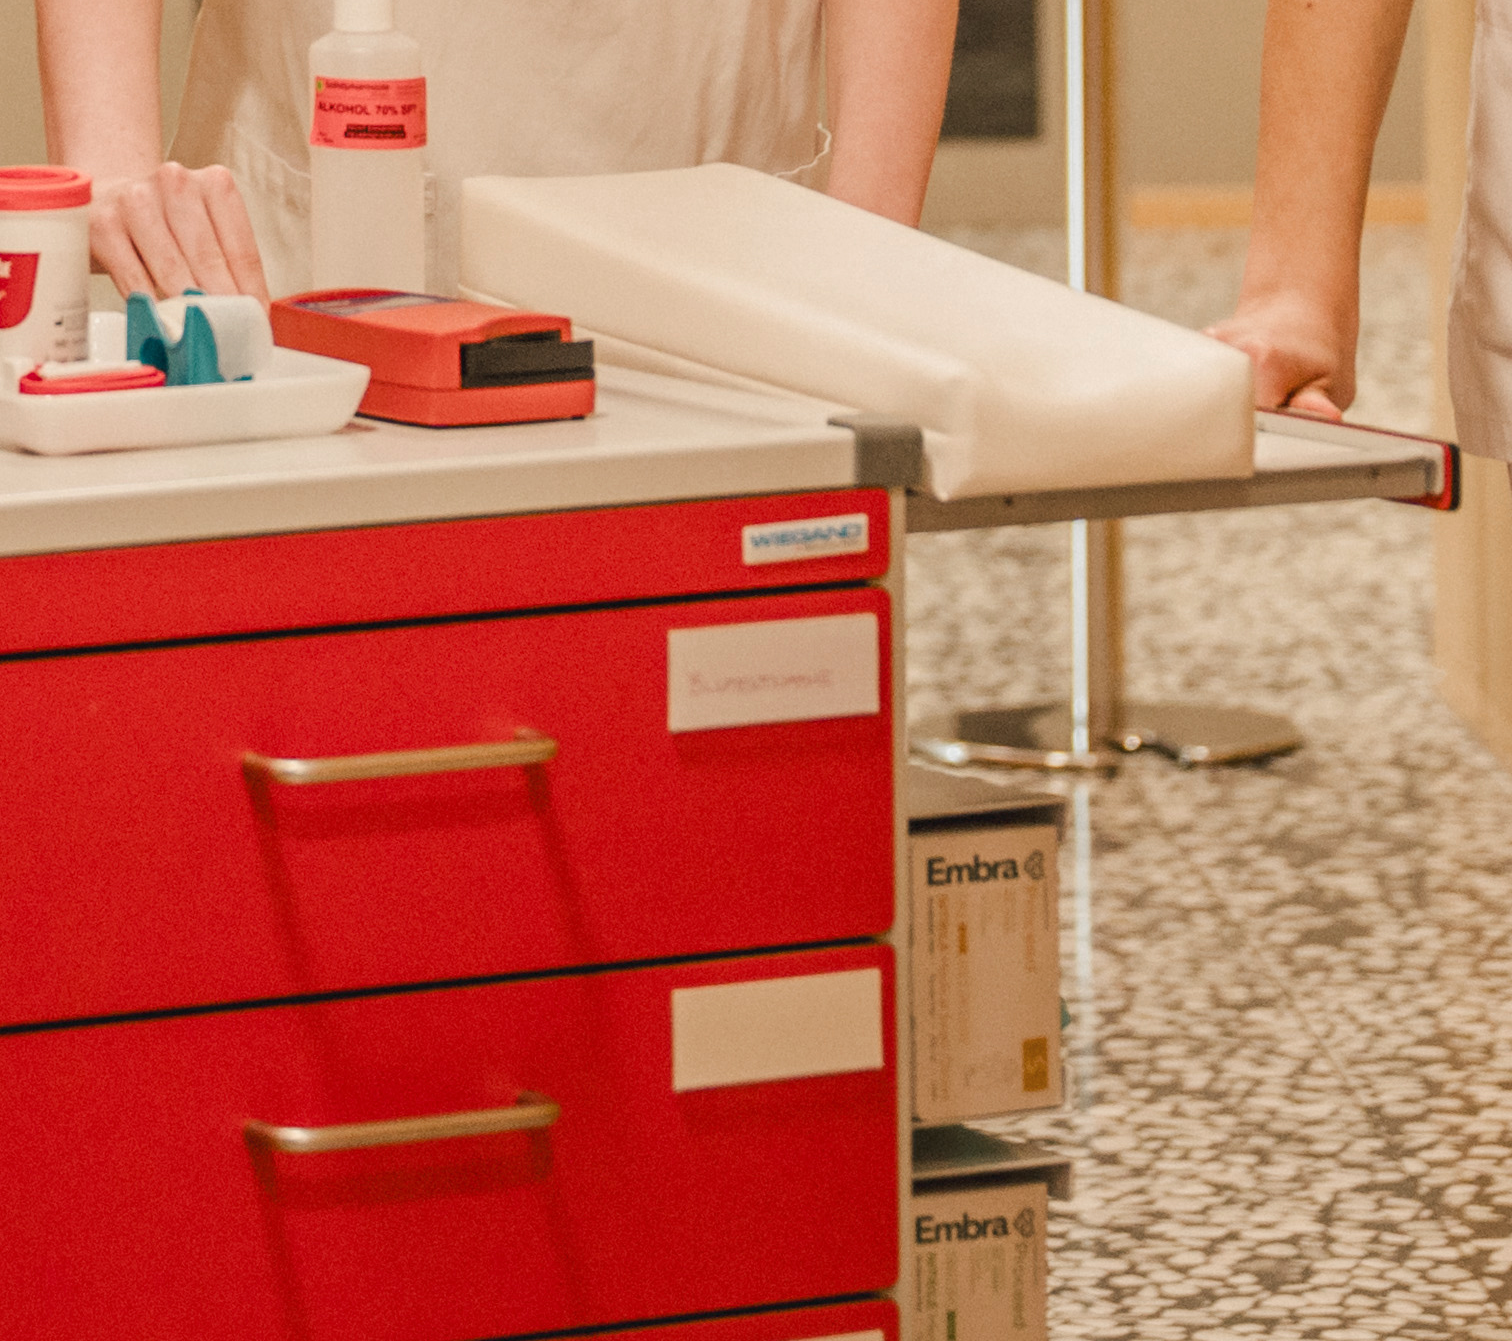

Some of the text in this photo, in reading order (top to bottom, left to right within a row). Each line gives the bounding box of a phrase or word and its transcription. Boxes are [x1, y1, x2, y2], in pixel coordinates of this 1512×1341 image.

[318, 102, 371, 115] ALKOHOL
[927, 853, 1019, 887] Embra
[915, 1212, 1009, 1245] Embra
